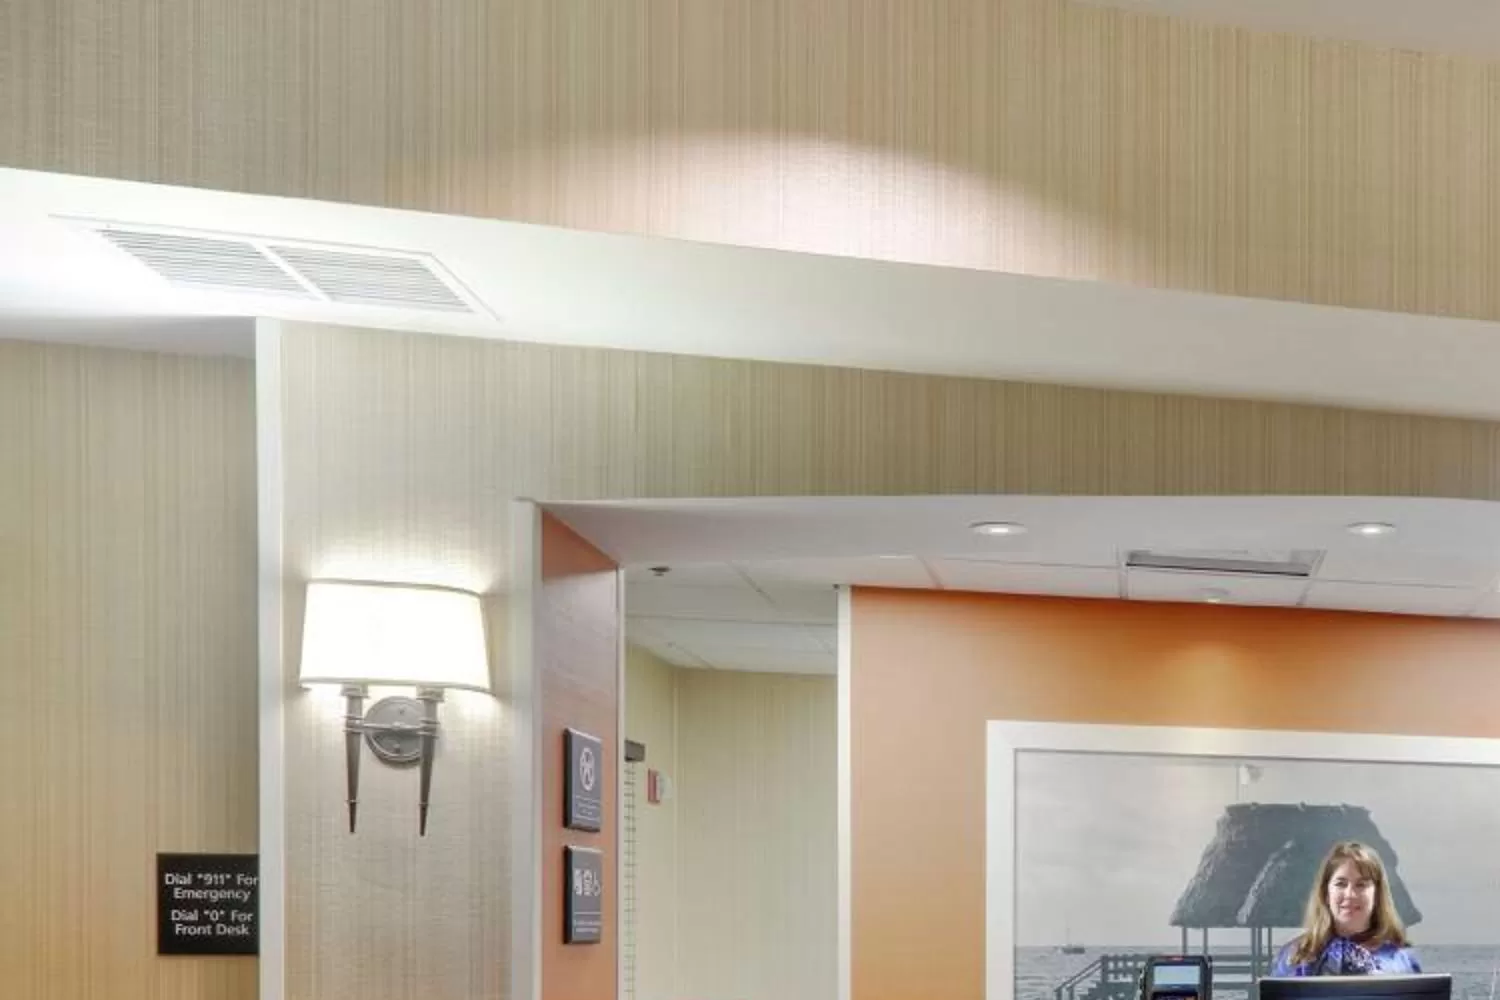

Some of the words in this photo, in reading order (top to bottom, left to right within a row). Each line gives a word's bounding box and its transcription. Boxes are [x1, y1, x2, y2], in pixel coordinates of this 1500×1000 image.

[164, 872, 193, 886] Dial
[237, 873, 260, 886] For
[173, 887, 252, 903] Emergency
[171, 909, 199, 922] Dial
[231, 910, 254, 923] For
[175, 923, 213, 936] Front
[216, 923, 250, 936] Desk
